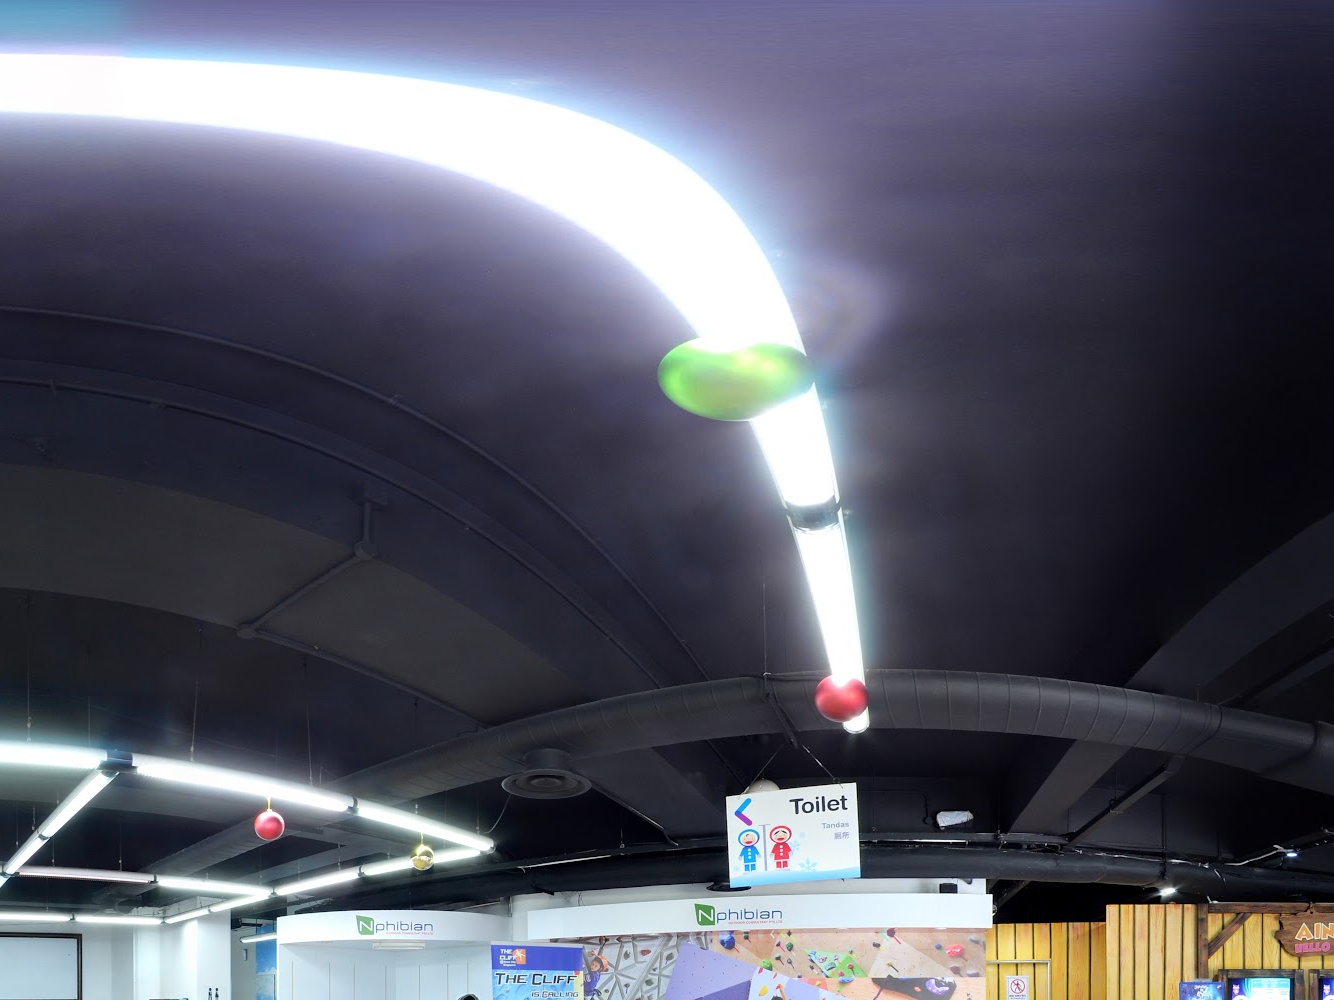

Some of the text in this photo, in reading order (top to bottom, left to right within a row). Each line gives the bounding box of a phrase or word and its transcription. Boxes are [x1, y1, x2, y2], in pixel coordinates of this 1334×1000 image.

[789, 795, 848, 814] Toilet
[698, 908, 783, 923] Nphibian
[359, 920, 433, 933] Nphibian
[1294, 942, 1330, 953] HELLO
[495, 973, 578, 985] THE CLIFF
